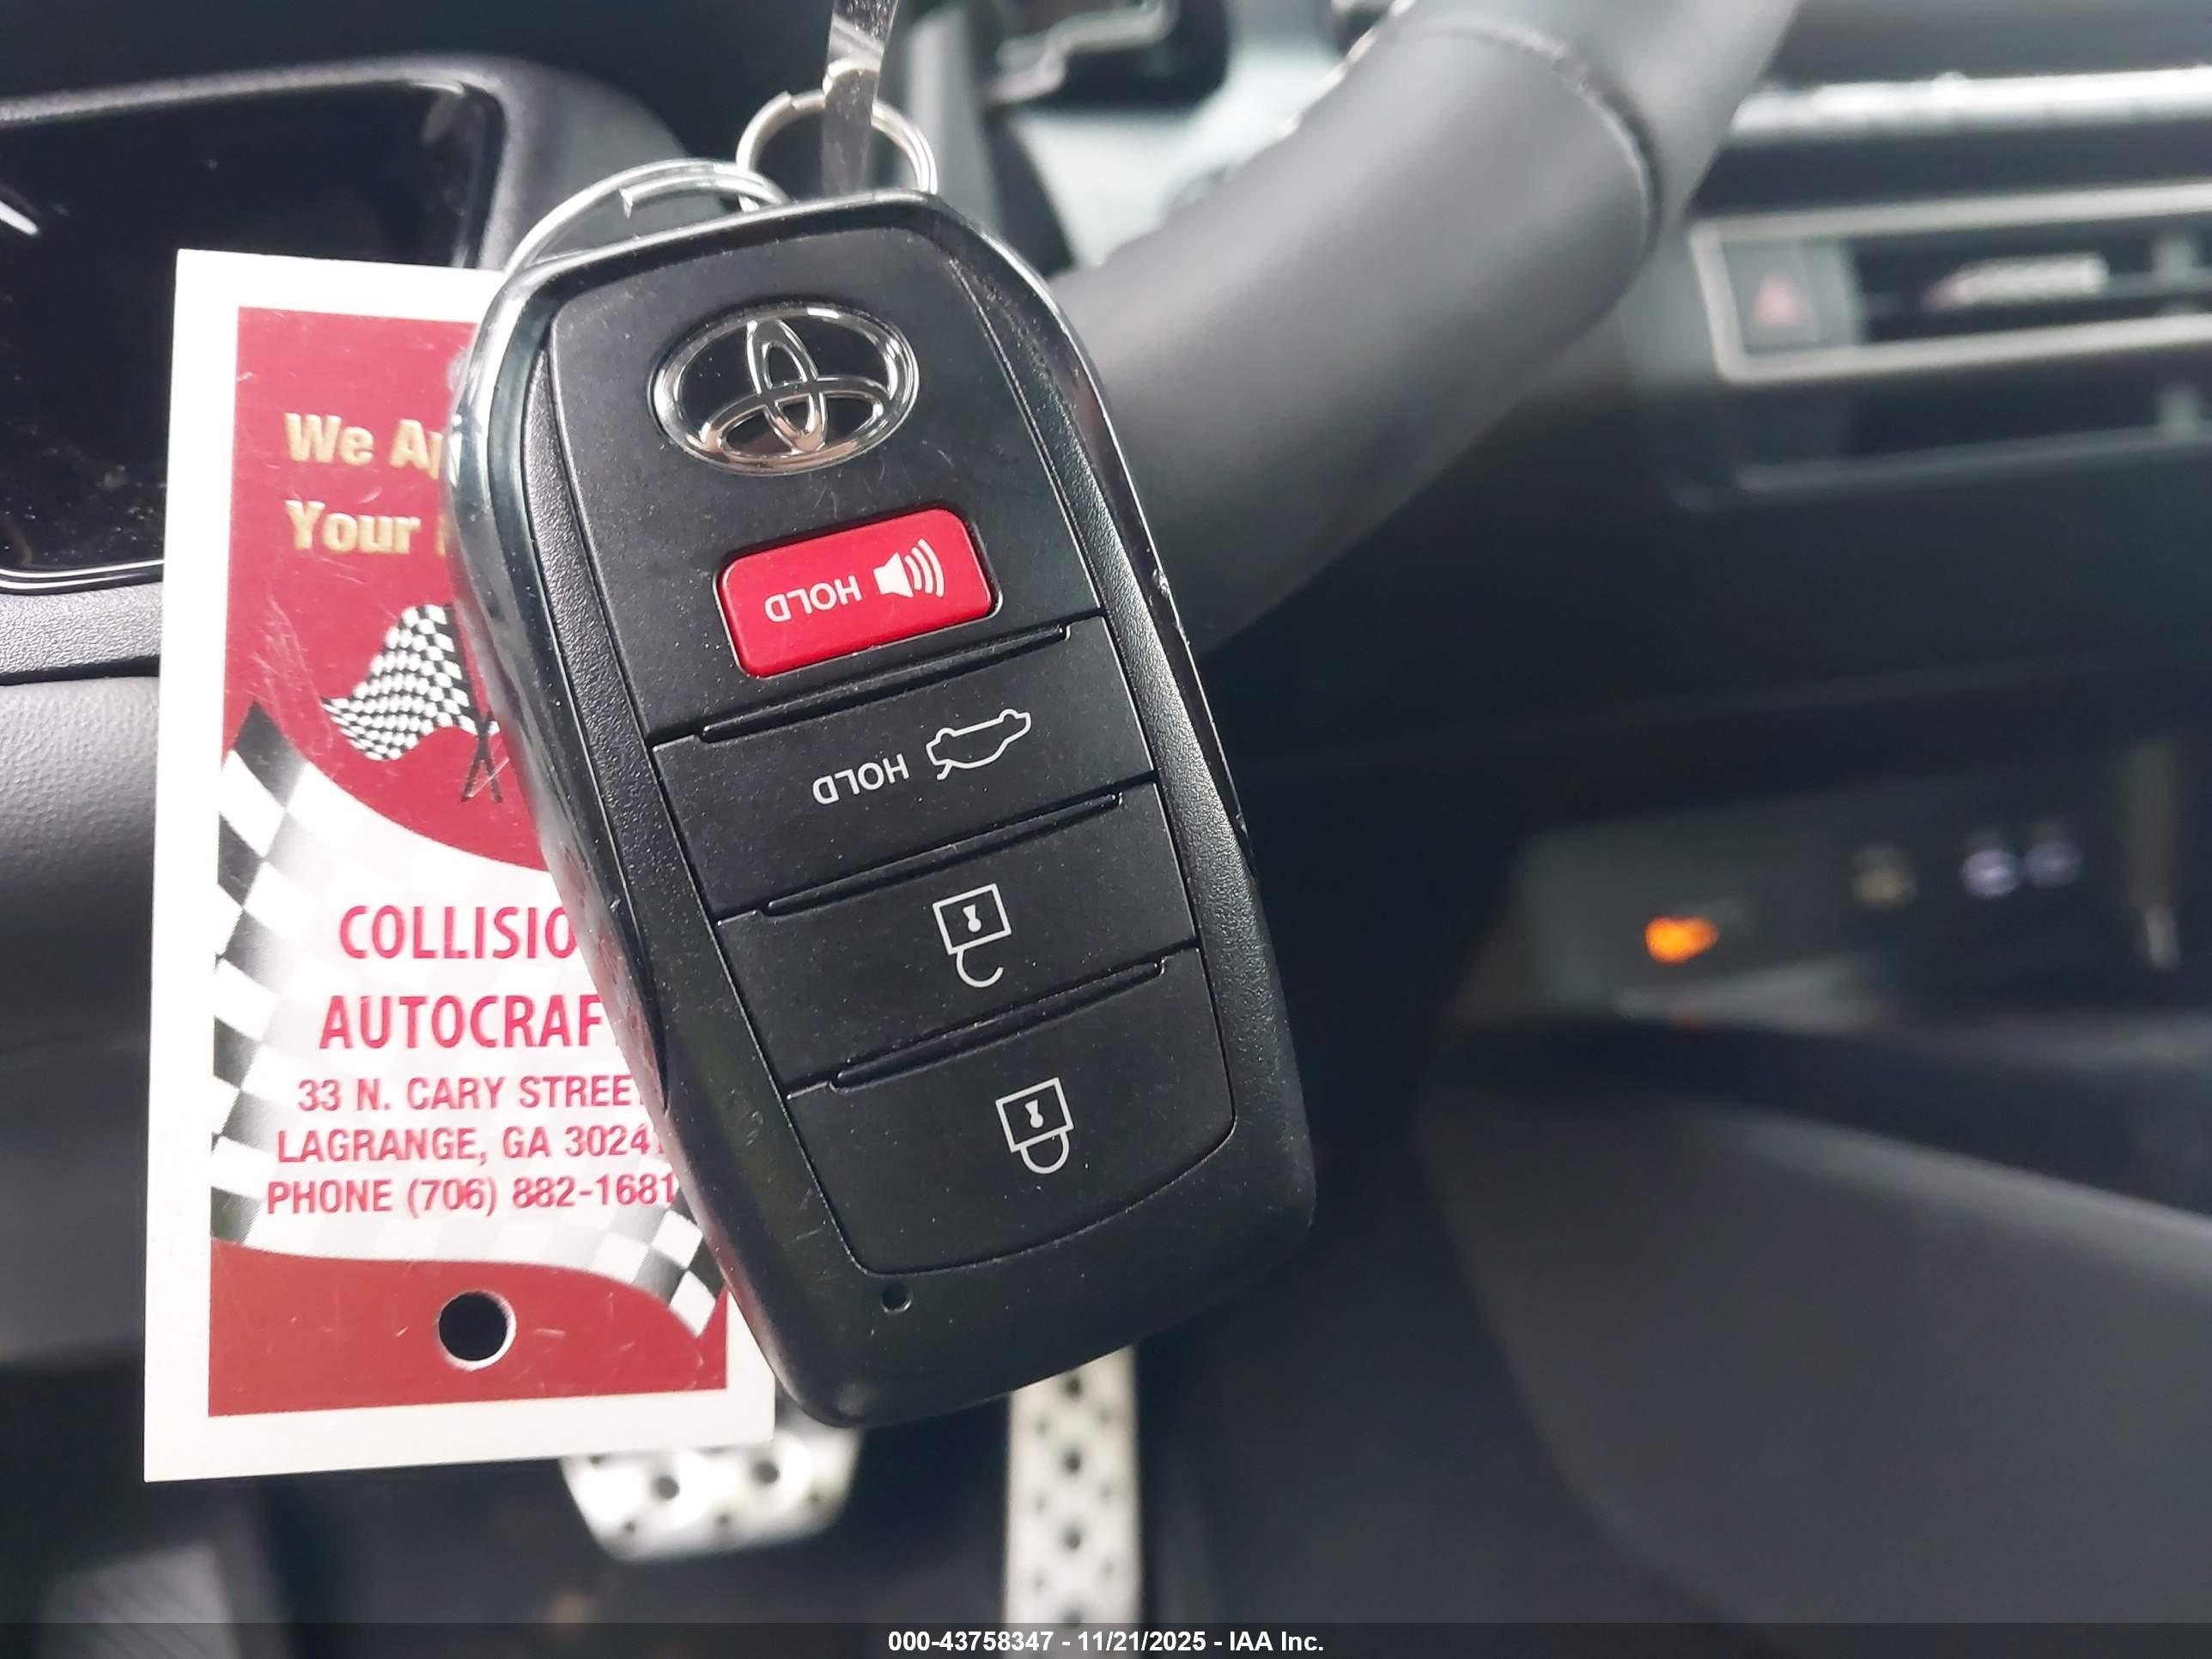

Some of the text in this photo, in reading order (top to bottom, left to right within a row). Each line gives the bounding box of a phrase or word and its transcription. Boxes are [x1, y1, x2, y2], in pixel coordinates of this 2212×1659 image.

[284, 411, 374, 466] We
[284, 499, 422, 556] Your
[764, 574, 863, 623] HOLD
[811, 753, 910, 805] HOLD
[339, 905, 579, 960] COLLISIO
[319, 994, 605, 1049] AUTOCRAF
[298, 1074, 635, 1112] 33 N. CARY STREE
[277, 1127, 488, 1166] LAGRANGE,
[502, 1125, 551, 1159] GA
[267, 1171, 674, 1219] PHONE (706) 882-1681
